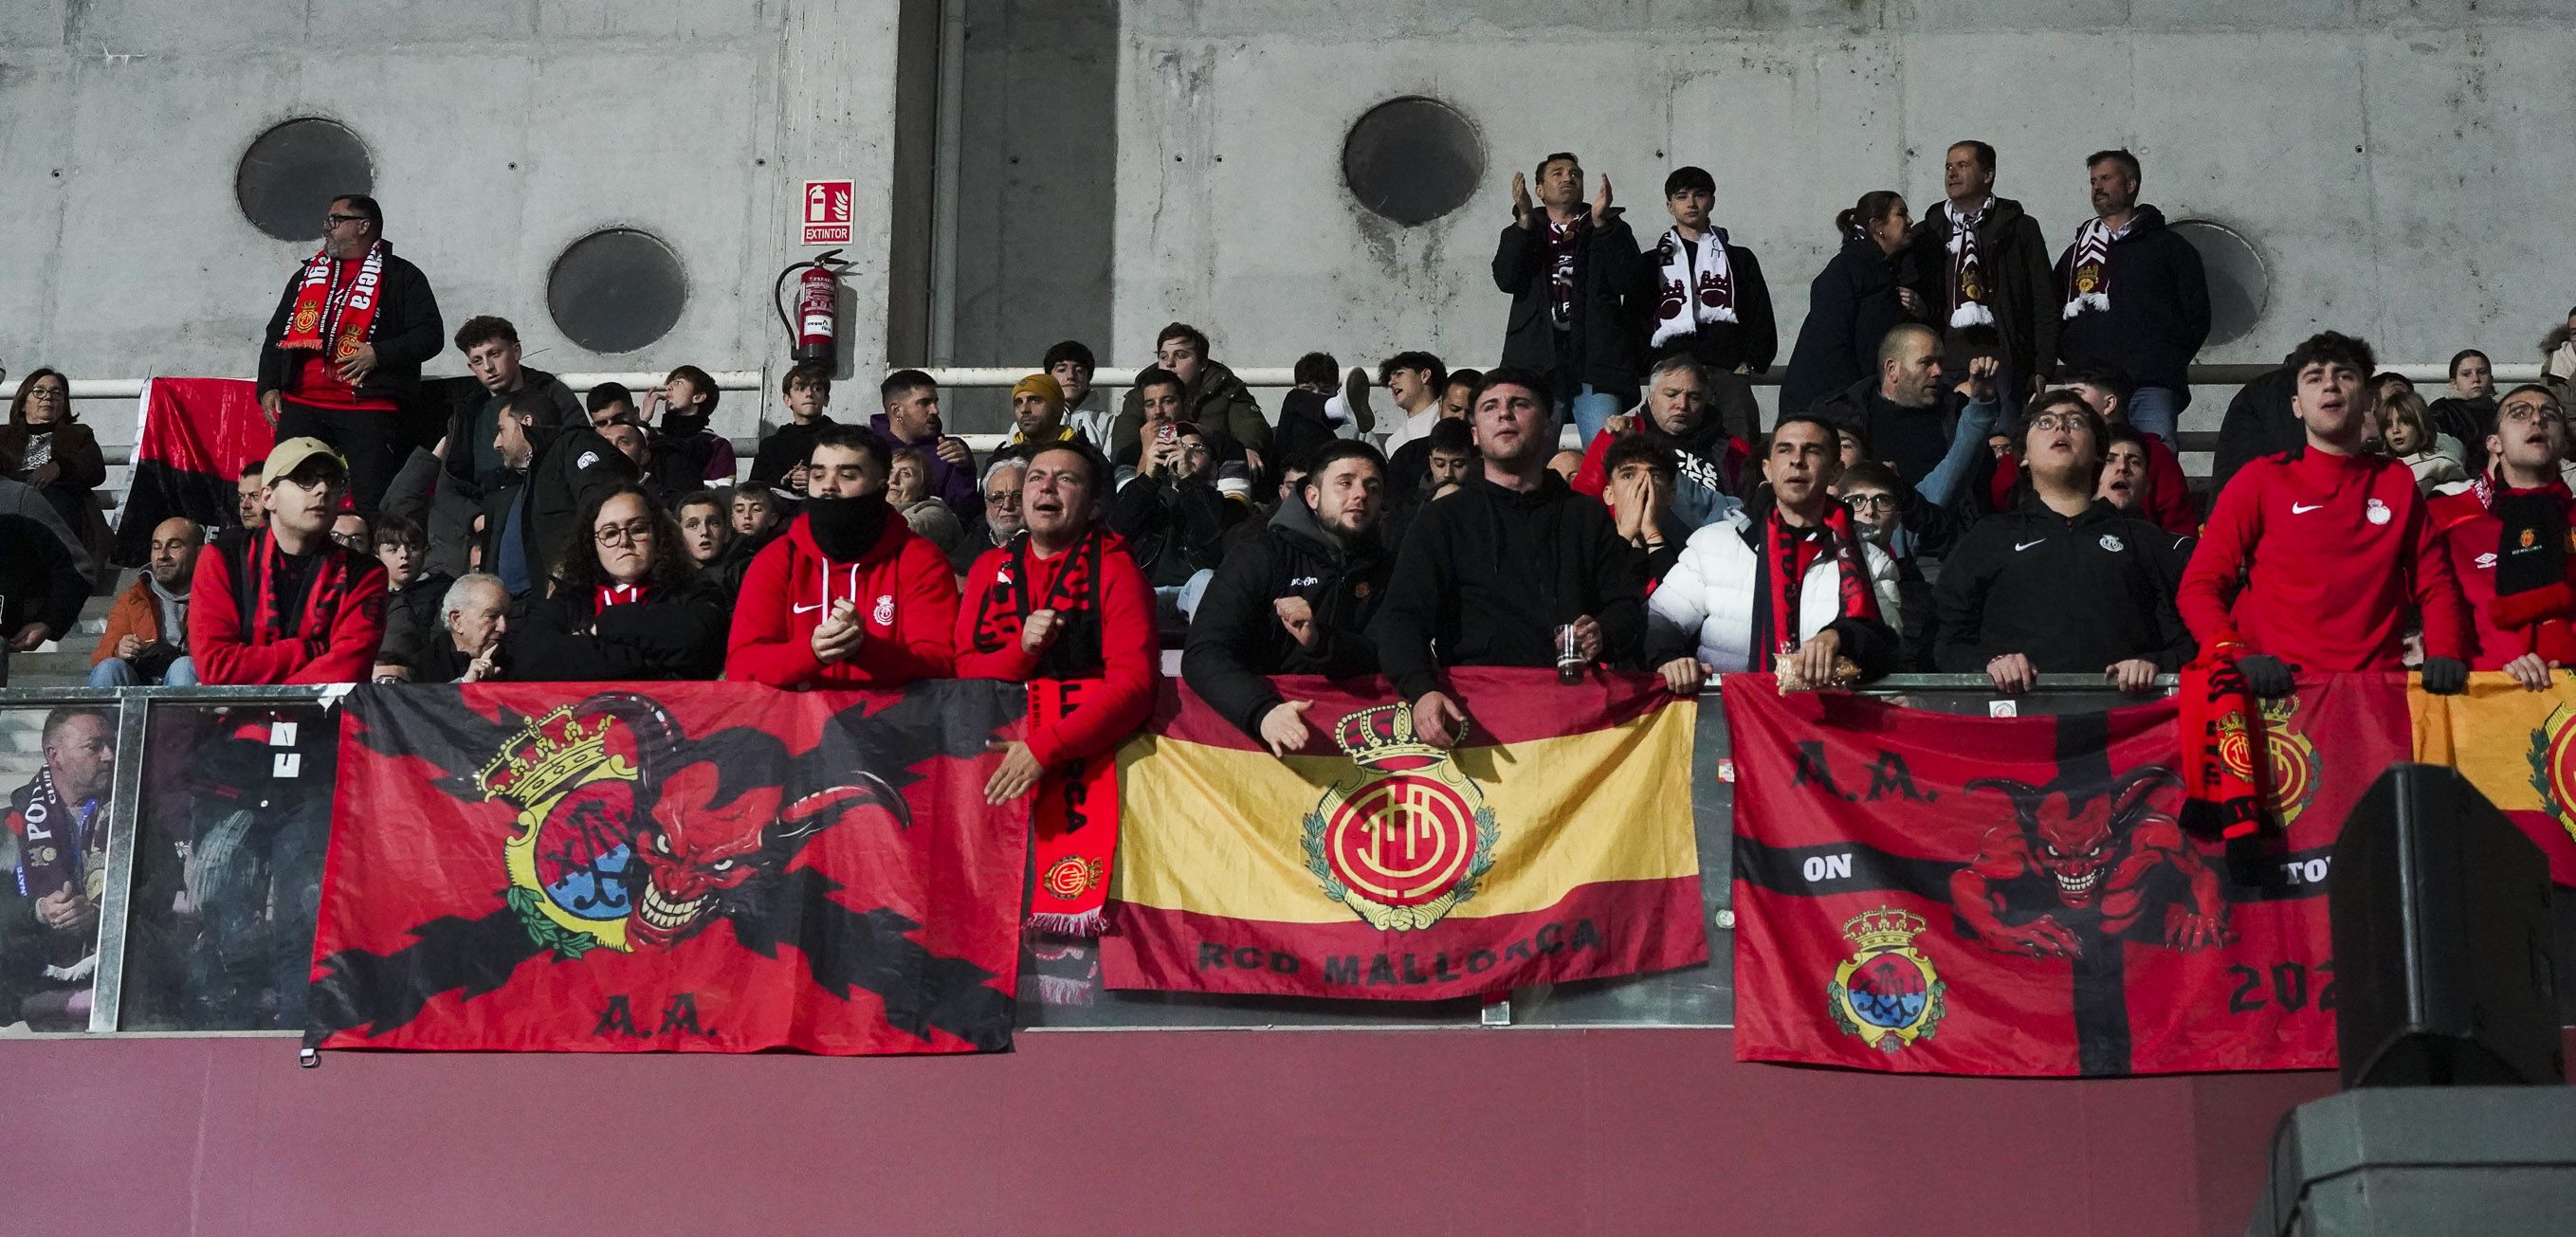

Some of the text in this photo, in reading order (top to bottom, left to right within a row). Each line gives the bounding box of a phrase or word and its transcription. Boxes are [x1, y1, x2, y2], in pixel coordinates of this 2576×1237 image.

[806, 227, 848, 241] EXTINTOR
[43, 770, 57, 805] CLUB
[1802, 853, 2332, 885] ON TO
[1197, 939, 1301, 975] RCD
